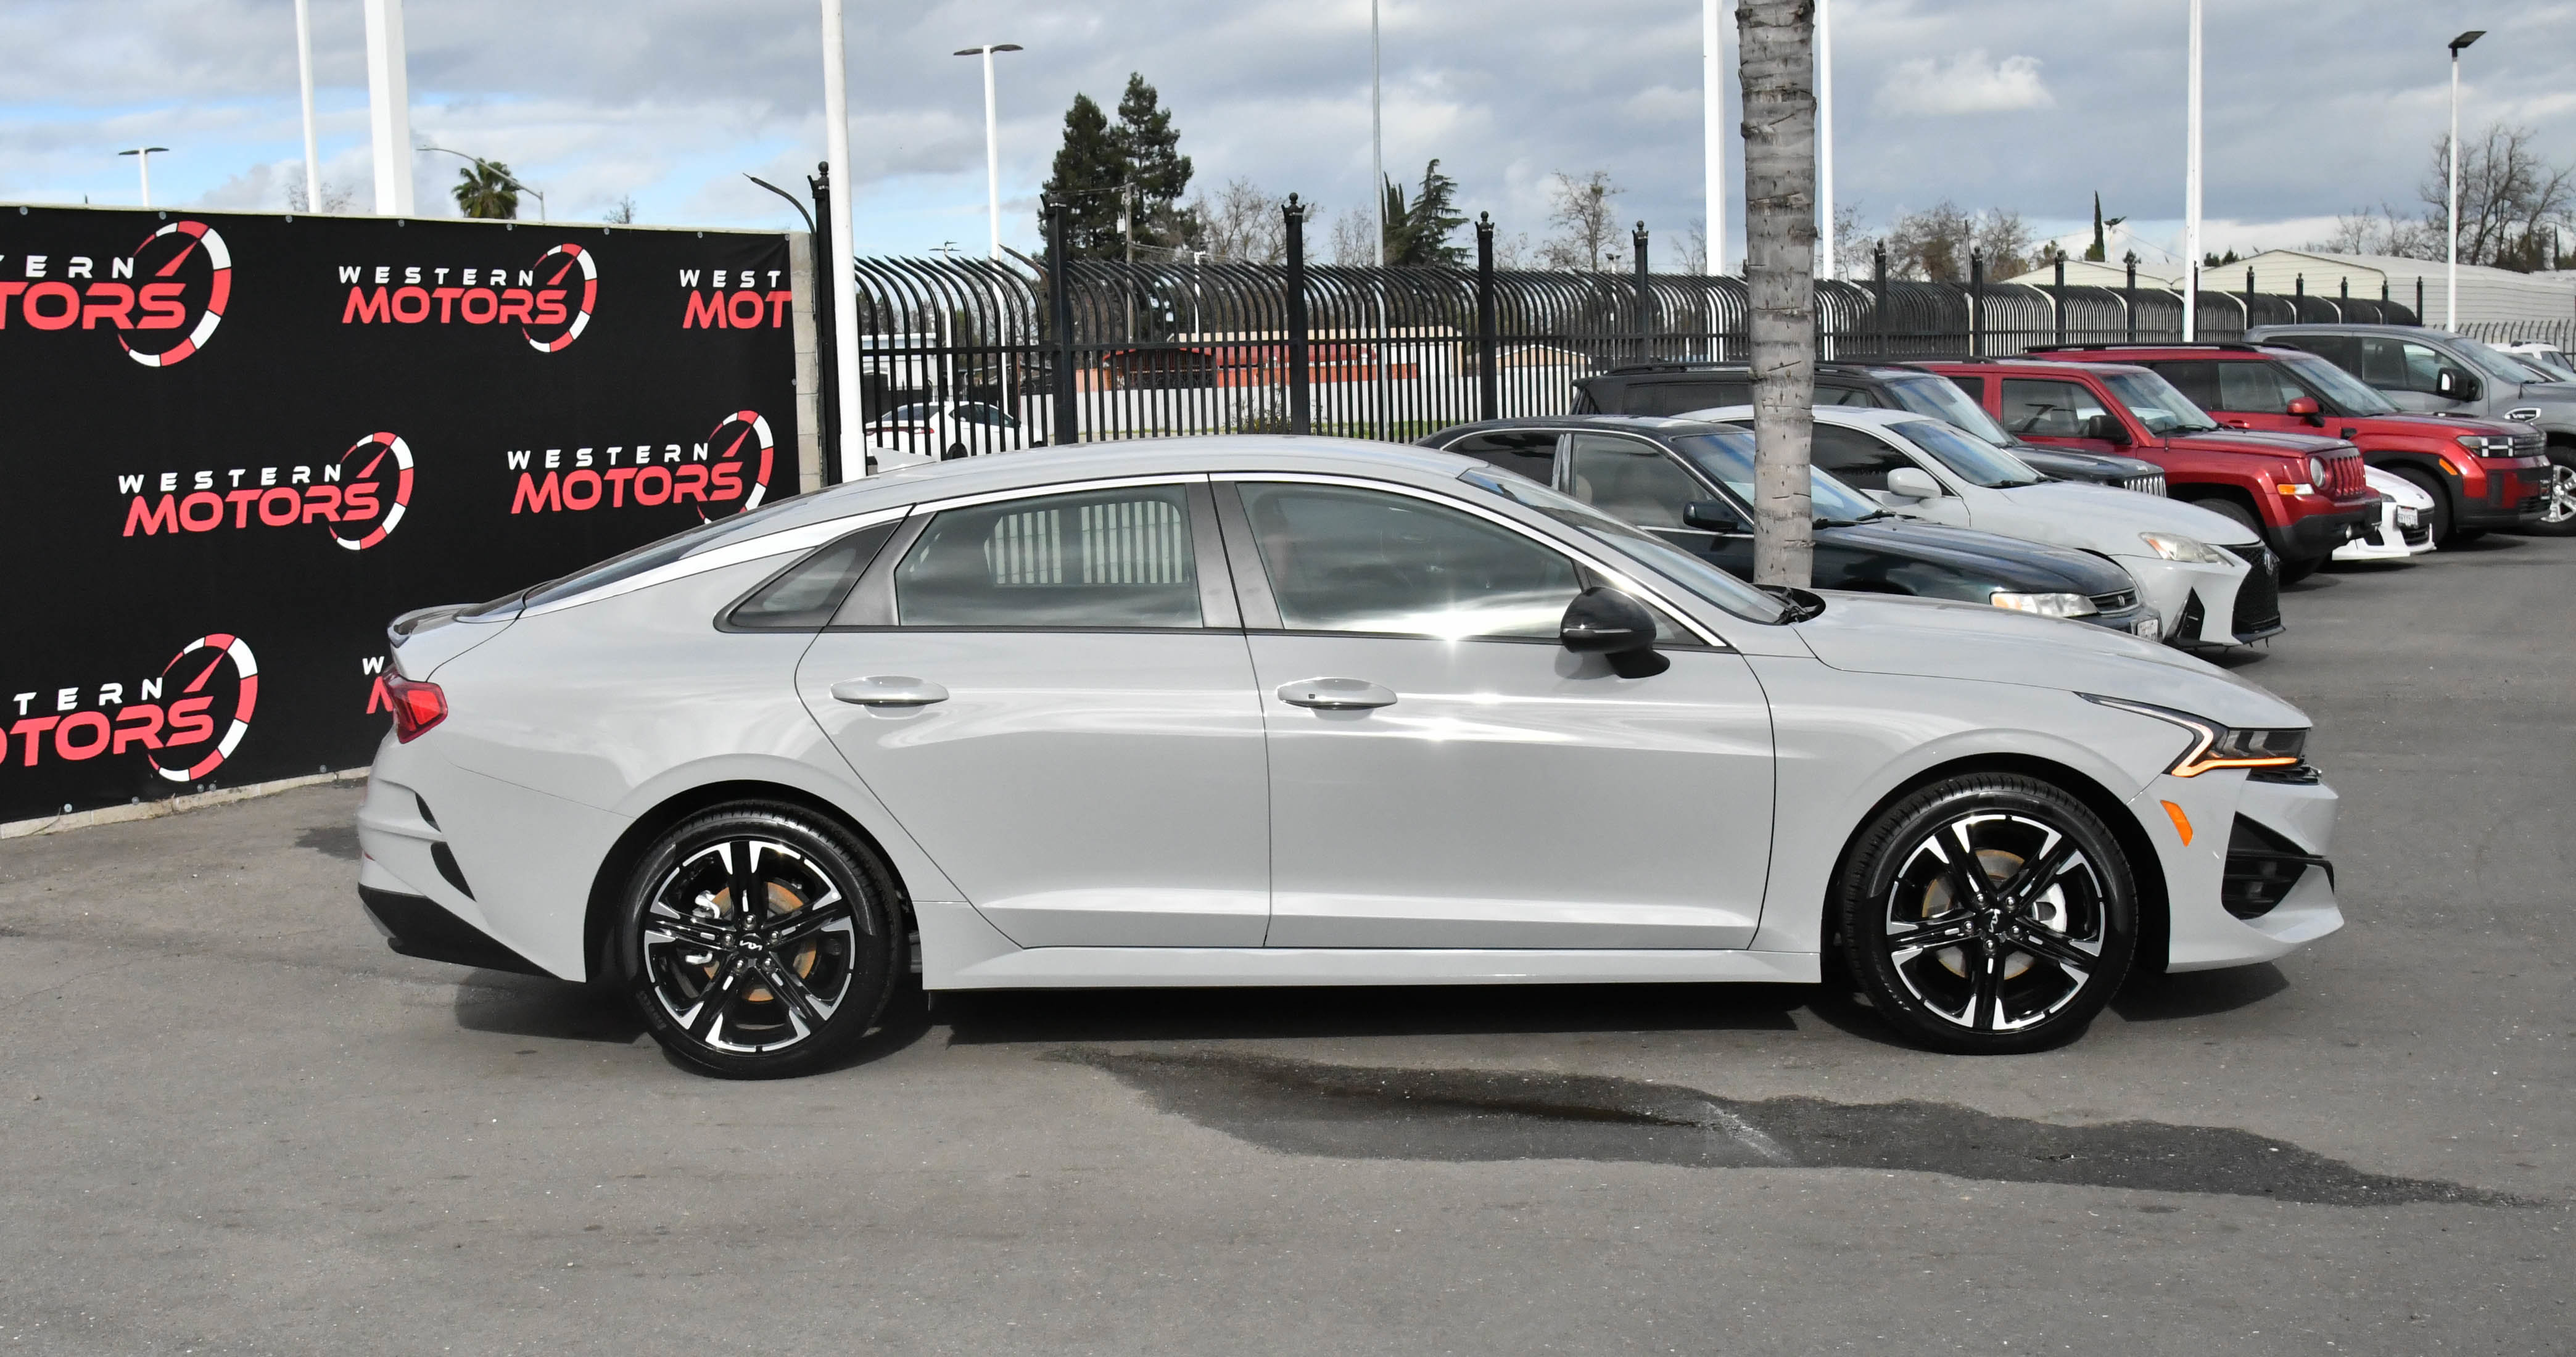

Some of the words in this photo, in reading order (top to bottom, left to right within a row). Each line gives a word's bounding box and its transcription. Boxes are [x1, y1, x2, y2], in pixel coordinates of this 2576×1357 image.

[0, 255, 134, 279] ERN
[339, 266, 534, 287] WESTERN
[679, 269, 782, 289] WEST
[342, 286, 568, 324] MOTORS
[683, 290, 793, 329] MOT
[507, 442, 709, 471] WESTERN
[118, 464, 342, 495] WESTERN
[511, 461, 743, 514] MOTORS
[123, 482, 380, 537] MOTORS
[13, 677, 163, 716] TERN
[0, 696, 215, 767] TORS
